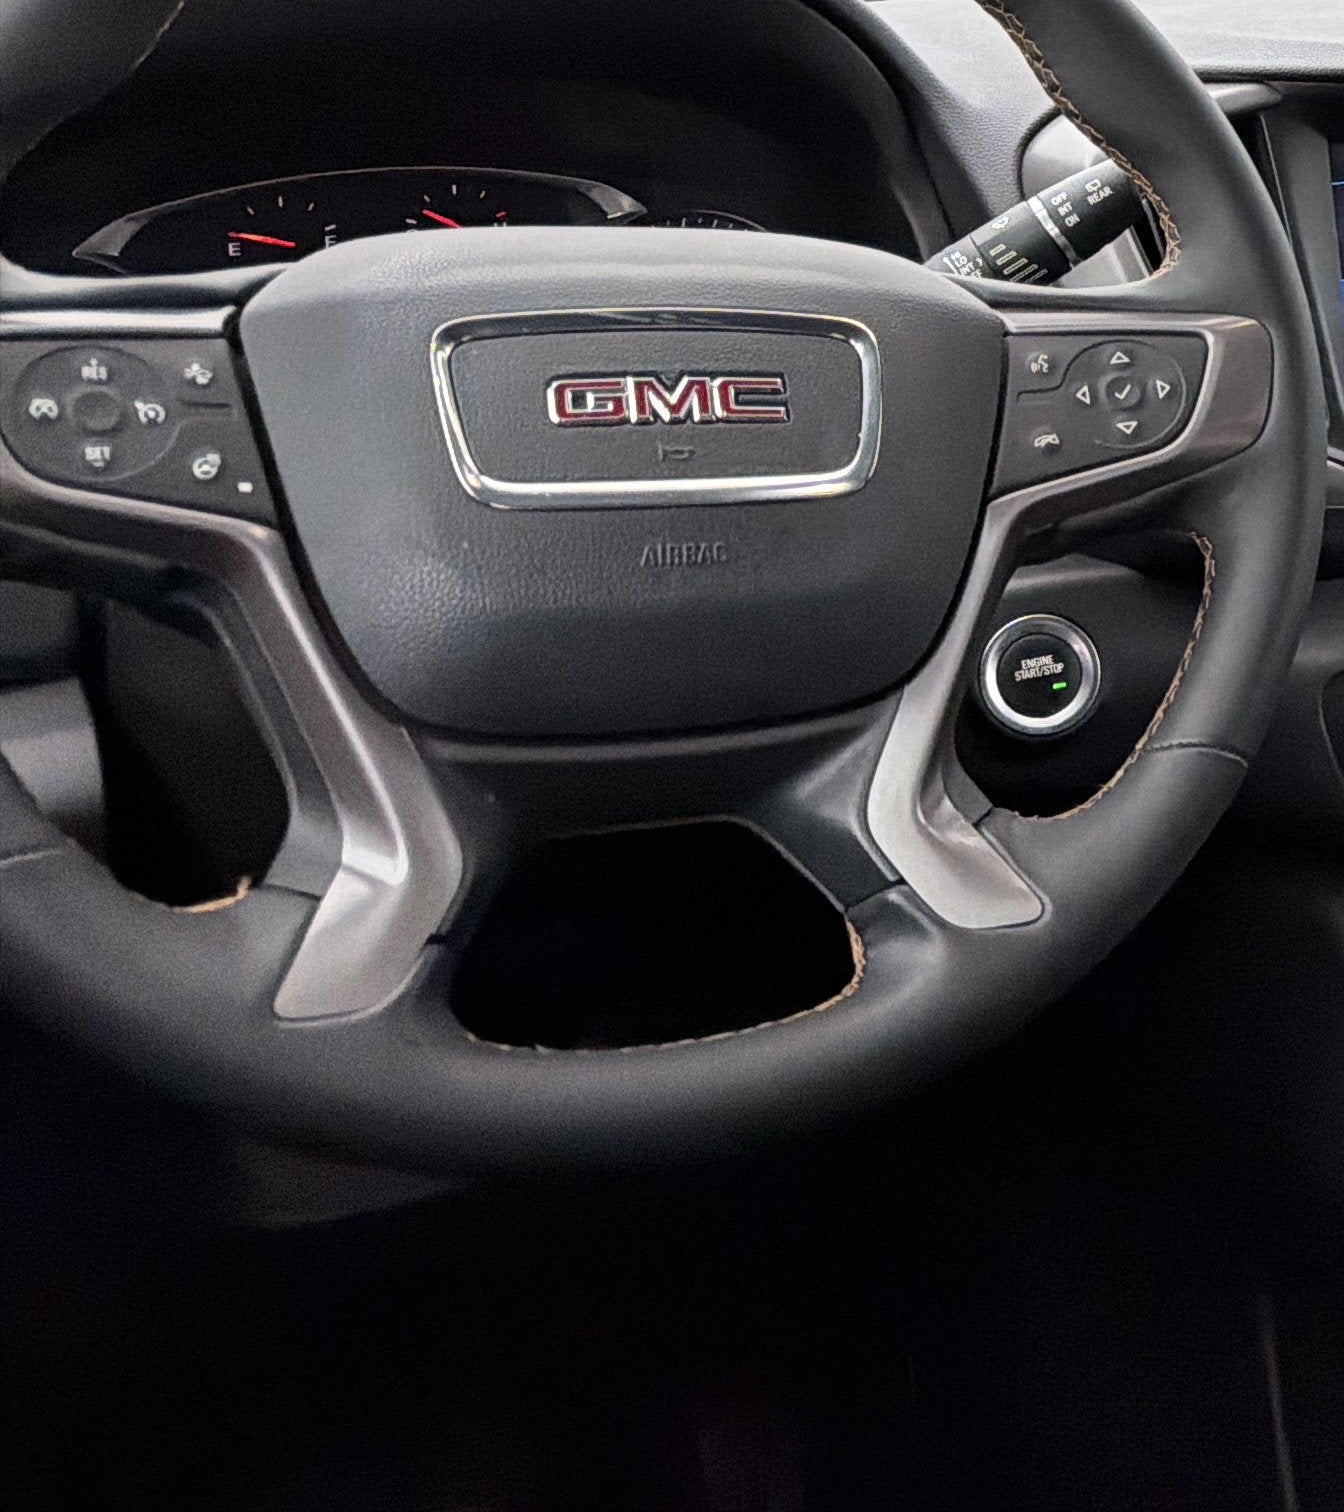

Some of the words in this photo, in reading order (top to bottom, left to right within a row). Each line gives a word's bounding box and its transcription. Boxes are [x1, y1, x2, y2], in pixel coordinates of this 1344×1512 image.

[1051, 192, 1068, 206] OFF
[1086, 186, 1113, 205] REAR
[1057, 204, 1072, 217] INT
[1065, 215, 1080, 227] ON
[228, 242, 242, 257] E
[547, 375, 789, 426] GMC
[639, 541, 728, 569] AIRBAG
[1021, 654, 1057, 670] ENGINE
[1014, 662, 1065, 682] START/STOP
